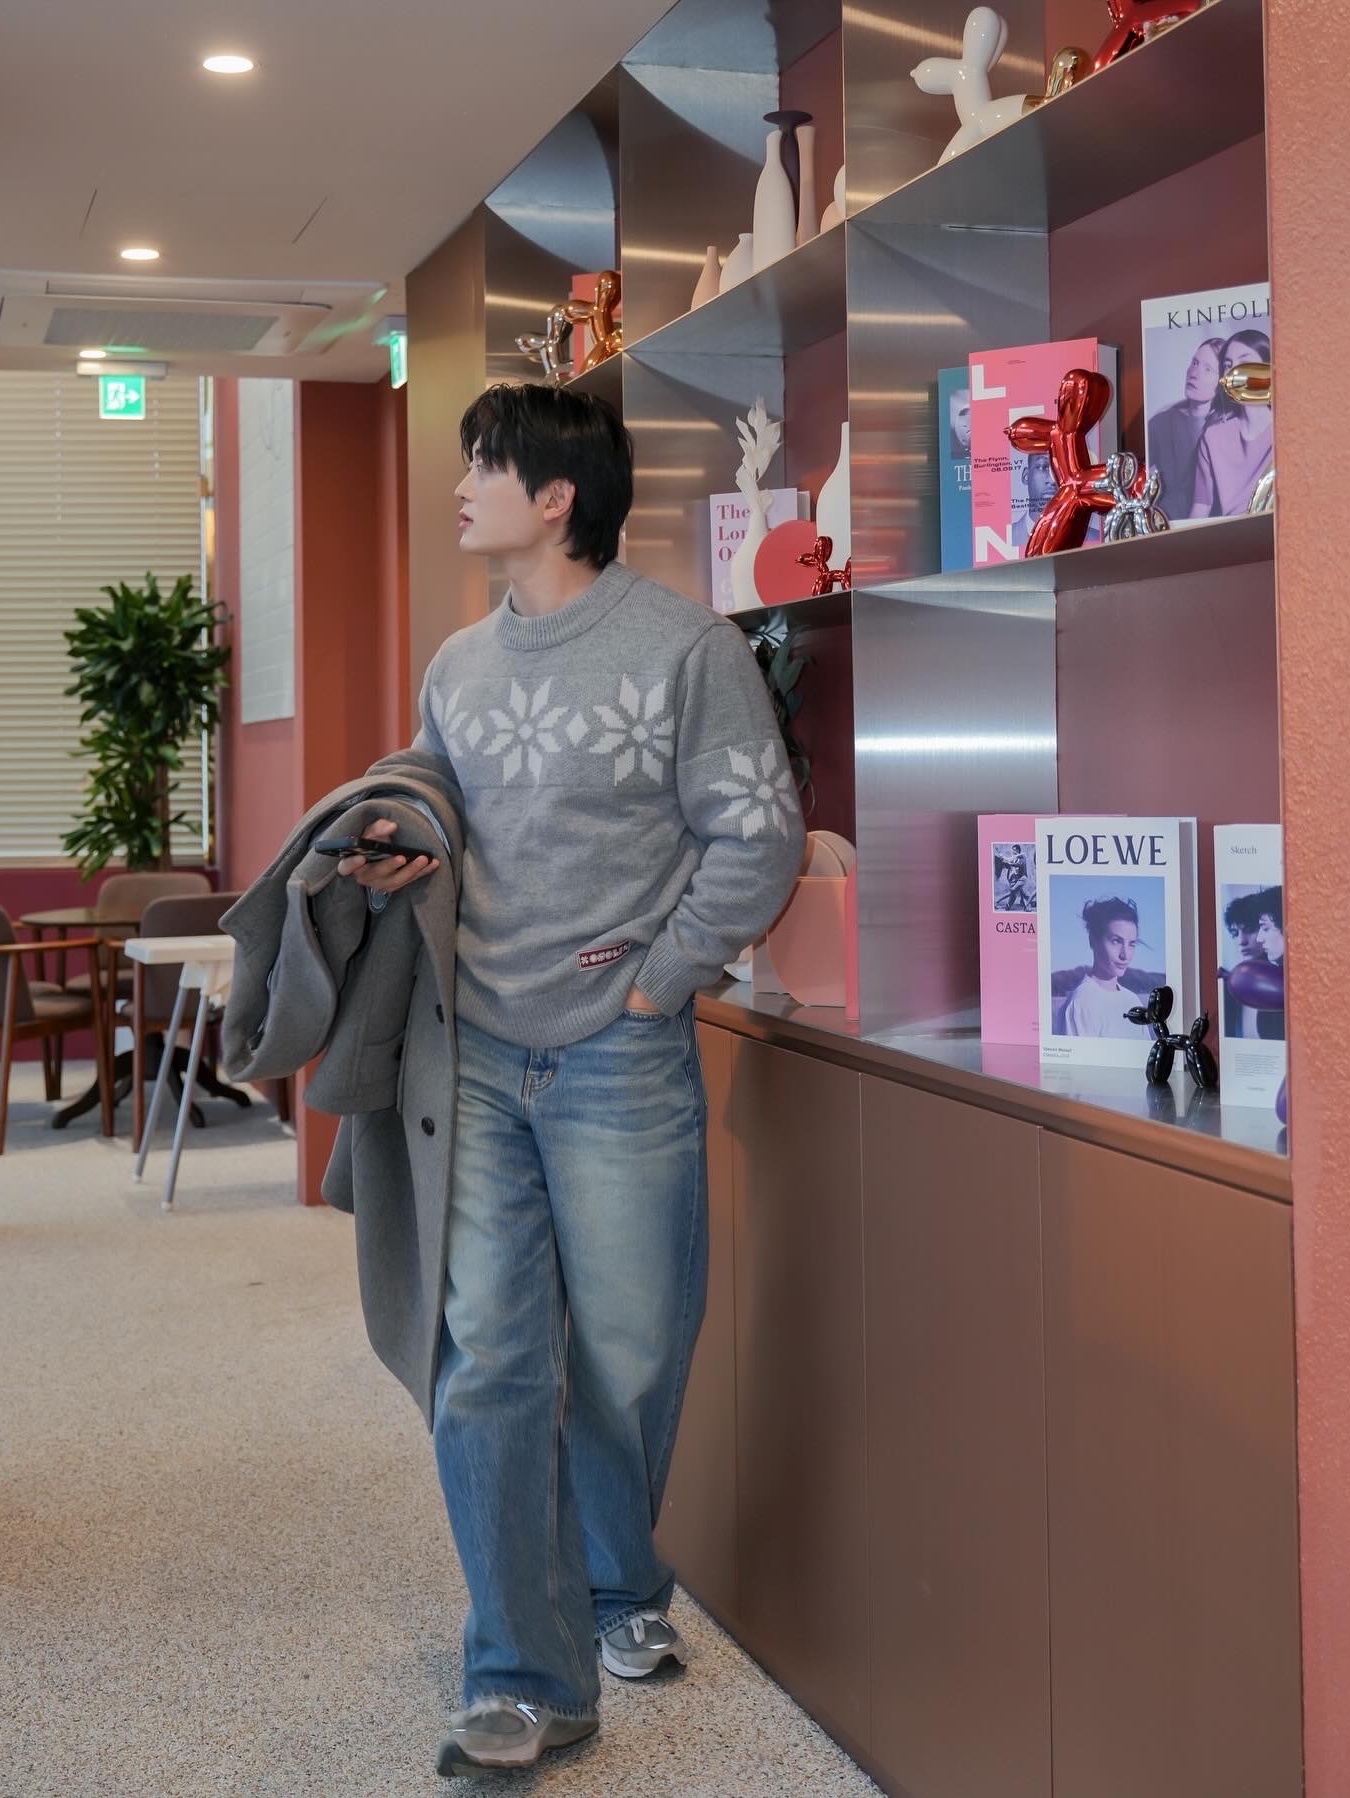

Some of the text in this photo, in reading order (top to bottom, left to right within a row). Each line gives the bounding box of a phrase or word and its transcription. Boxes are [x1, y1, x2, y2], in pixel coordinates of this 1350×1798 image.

[1167, 298, 1270, 329] KINFOL
[971, 364, 1006, 401] L
[716, 504, 750, 521] The
[718, 546, 736, 562] O
[975, 524, 1019, 562] N
[1046, 834, 1167, 866] LOEWE
[1230, 845, 1257, 855] Sketch
[996, 921, 1036, 934] CASTA
